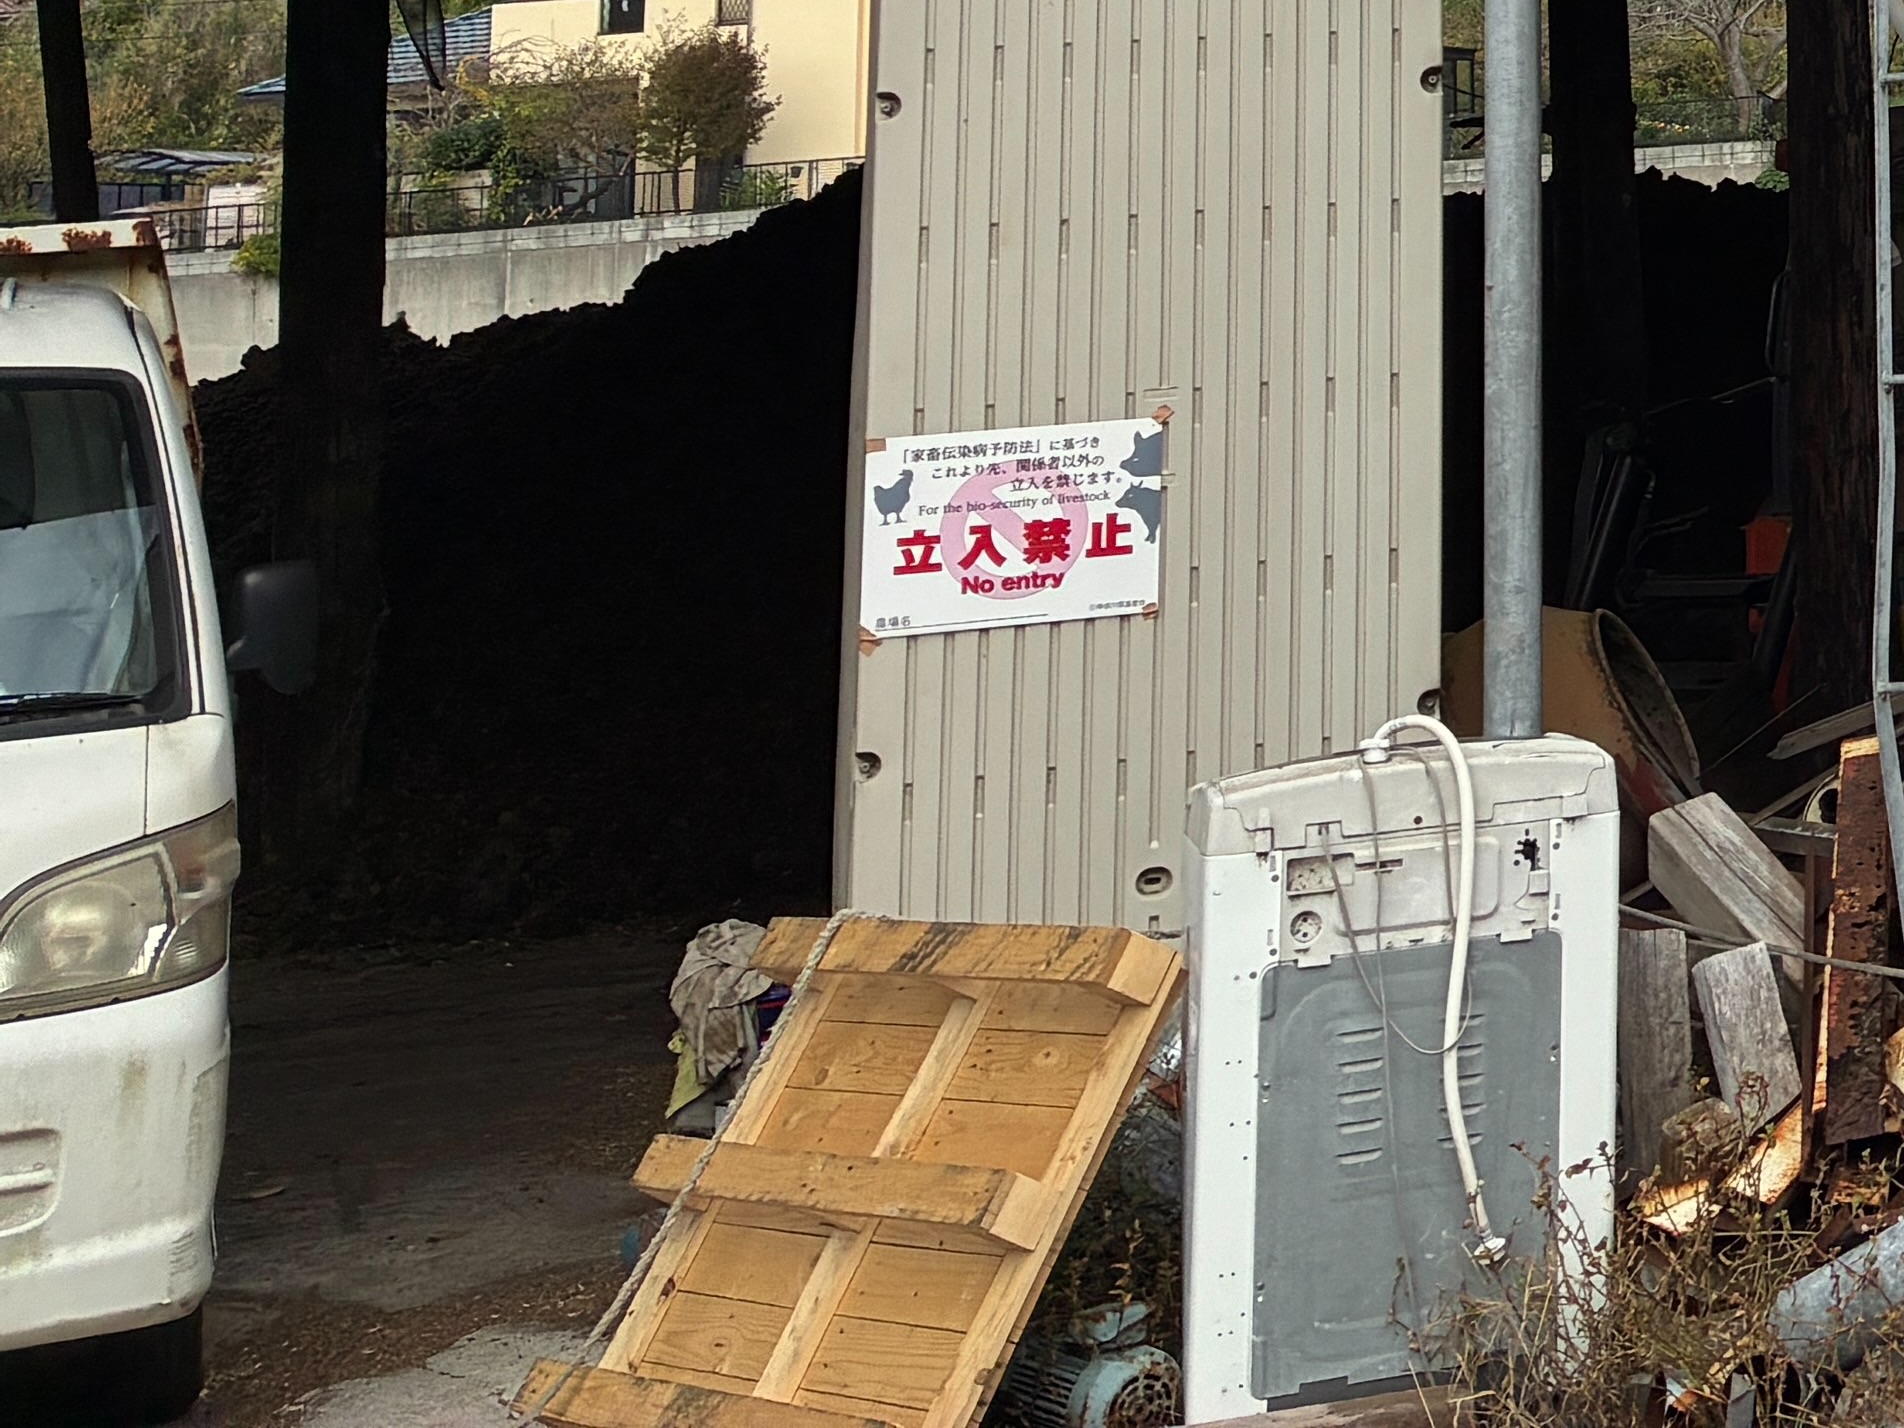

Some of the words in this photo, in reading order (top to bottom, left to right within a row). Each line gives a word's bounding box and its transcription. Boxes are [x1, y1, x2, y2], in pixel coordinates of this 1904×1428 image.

[918, 504, 938, 517] For
[943, 503, 963, 514] the
[966, 494, 1037, 514] bio-security
[1041, 494, 1056, 506] of
[1057, 489, 1111, 503] livestock
[893, 513, 1133, 575] 立入禁止
[960, 576, 995, 595] No
[1001, 571, 1065, 593] entry
